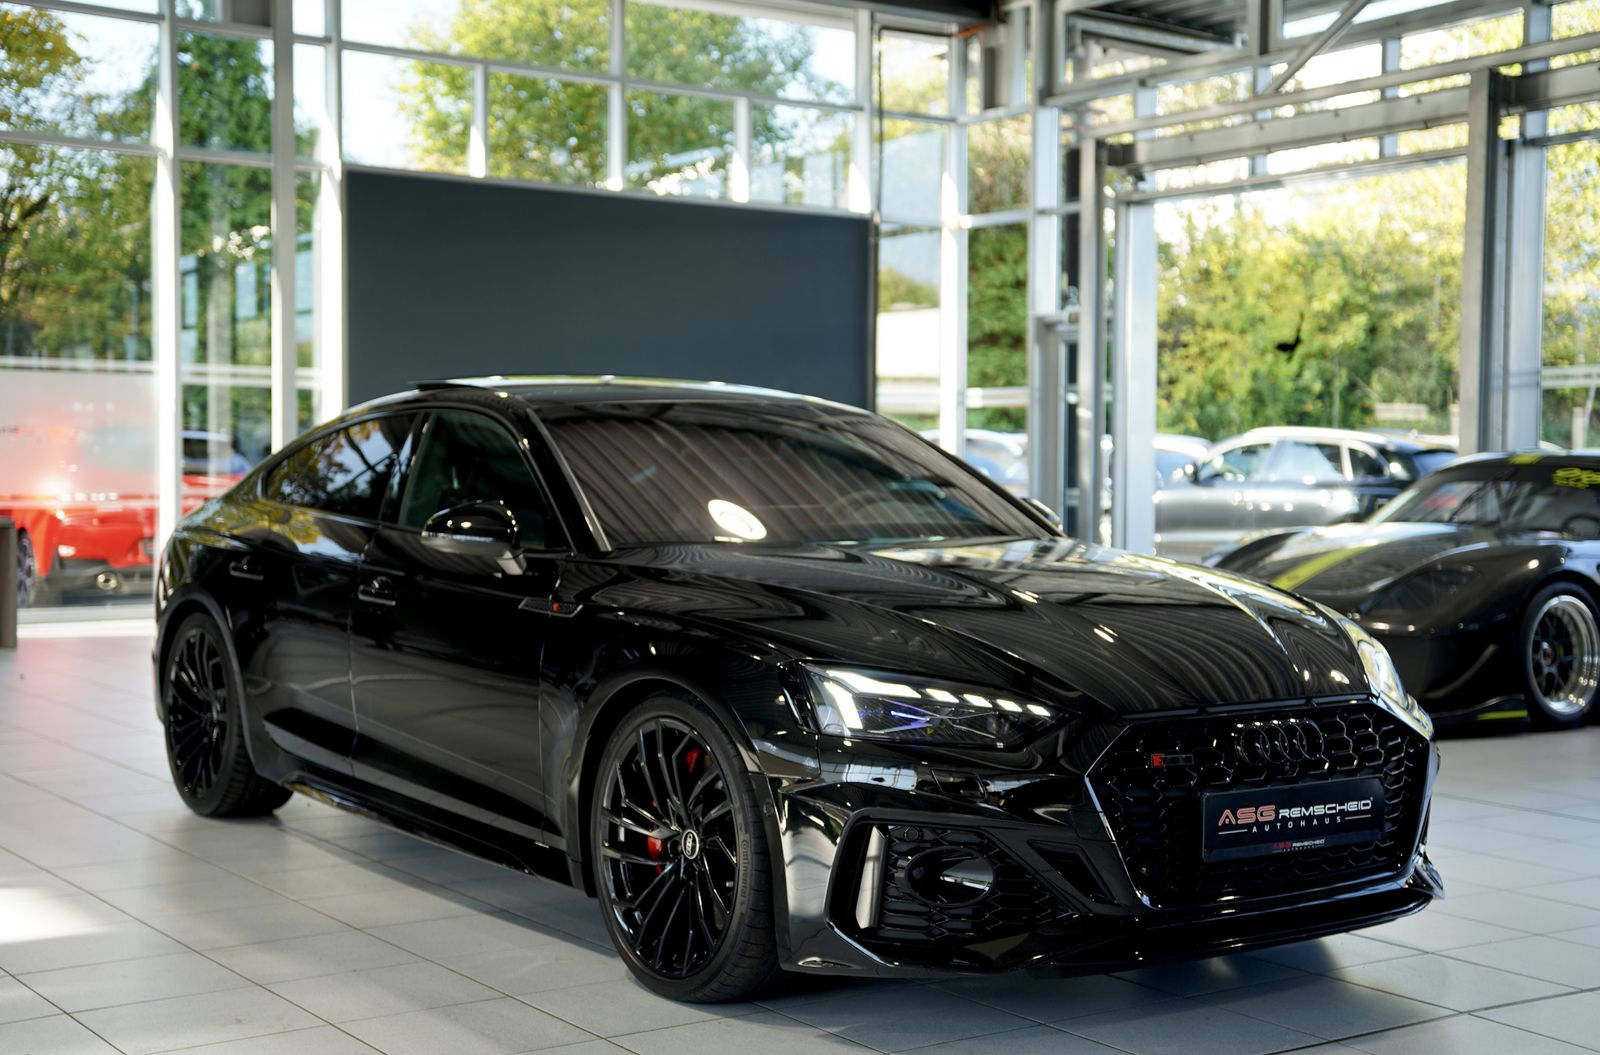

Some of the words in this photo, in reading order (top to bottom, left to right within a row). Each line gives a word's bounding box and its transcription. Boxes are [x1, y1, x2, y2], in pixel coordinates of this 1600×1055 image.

[1218, 804, 1276, 827] ASG
[1278, 799, 1372, 820] REMSCHEID
[1252, 816, 1341, 833] AUTOHAUS
